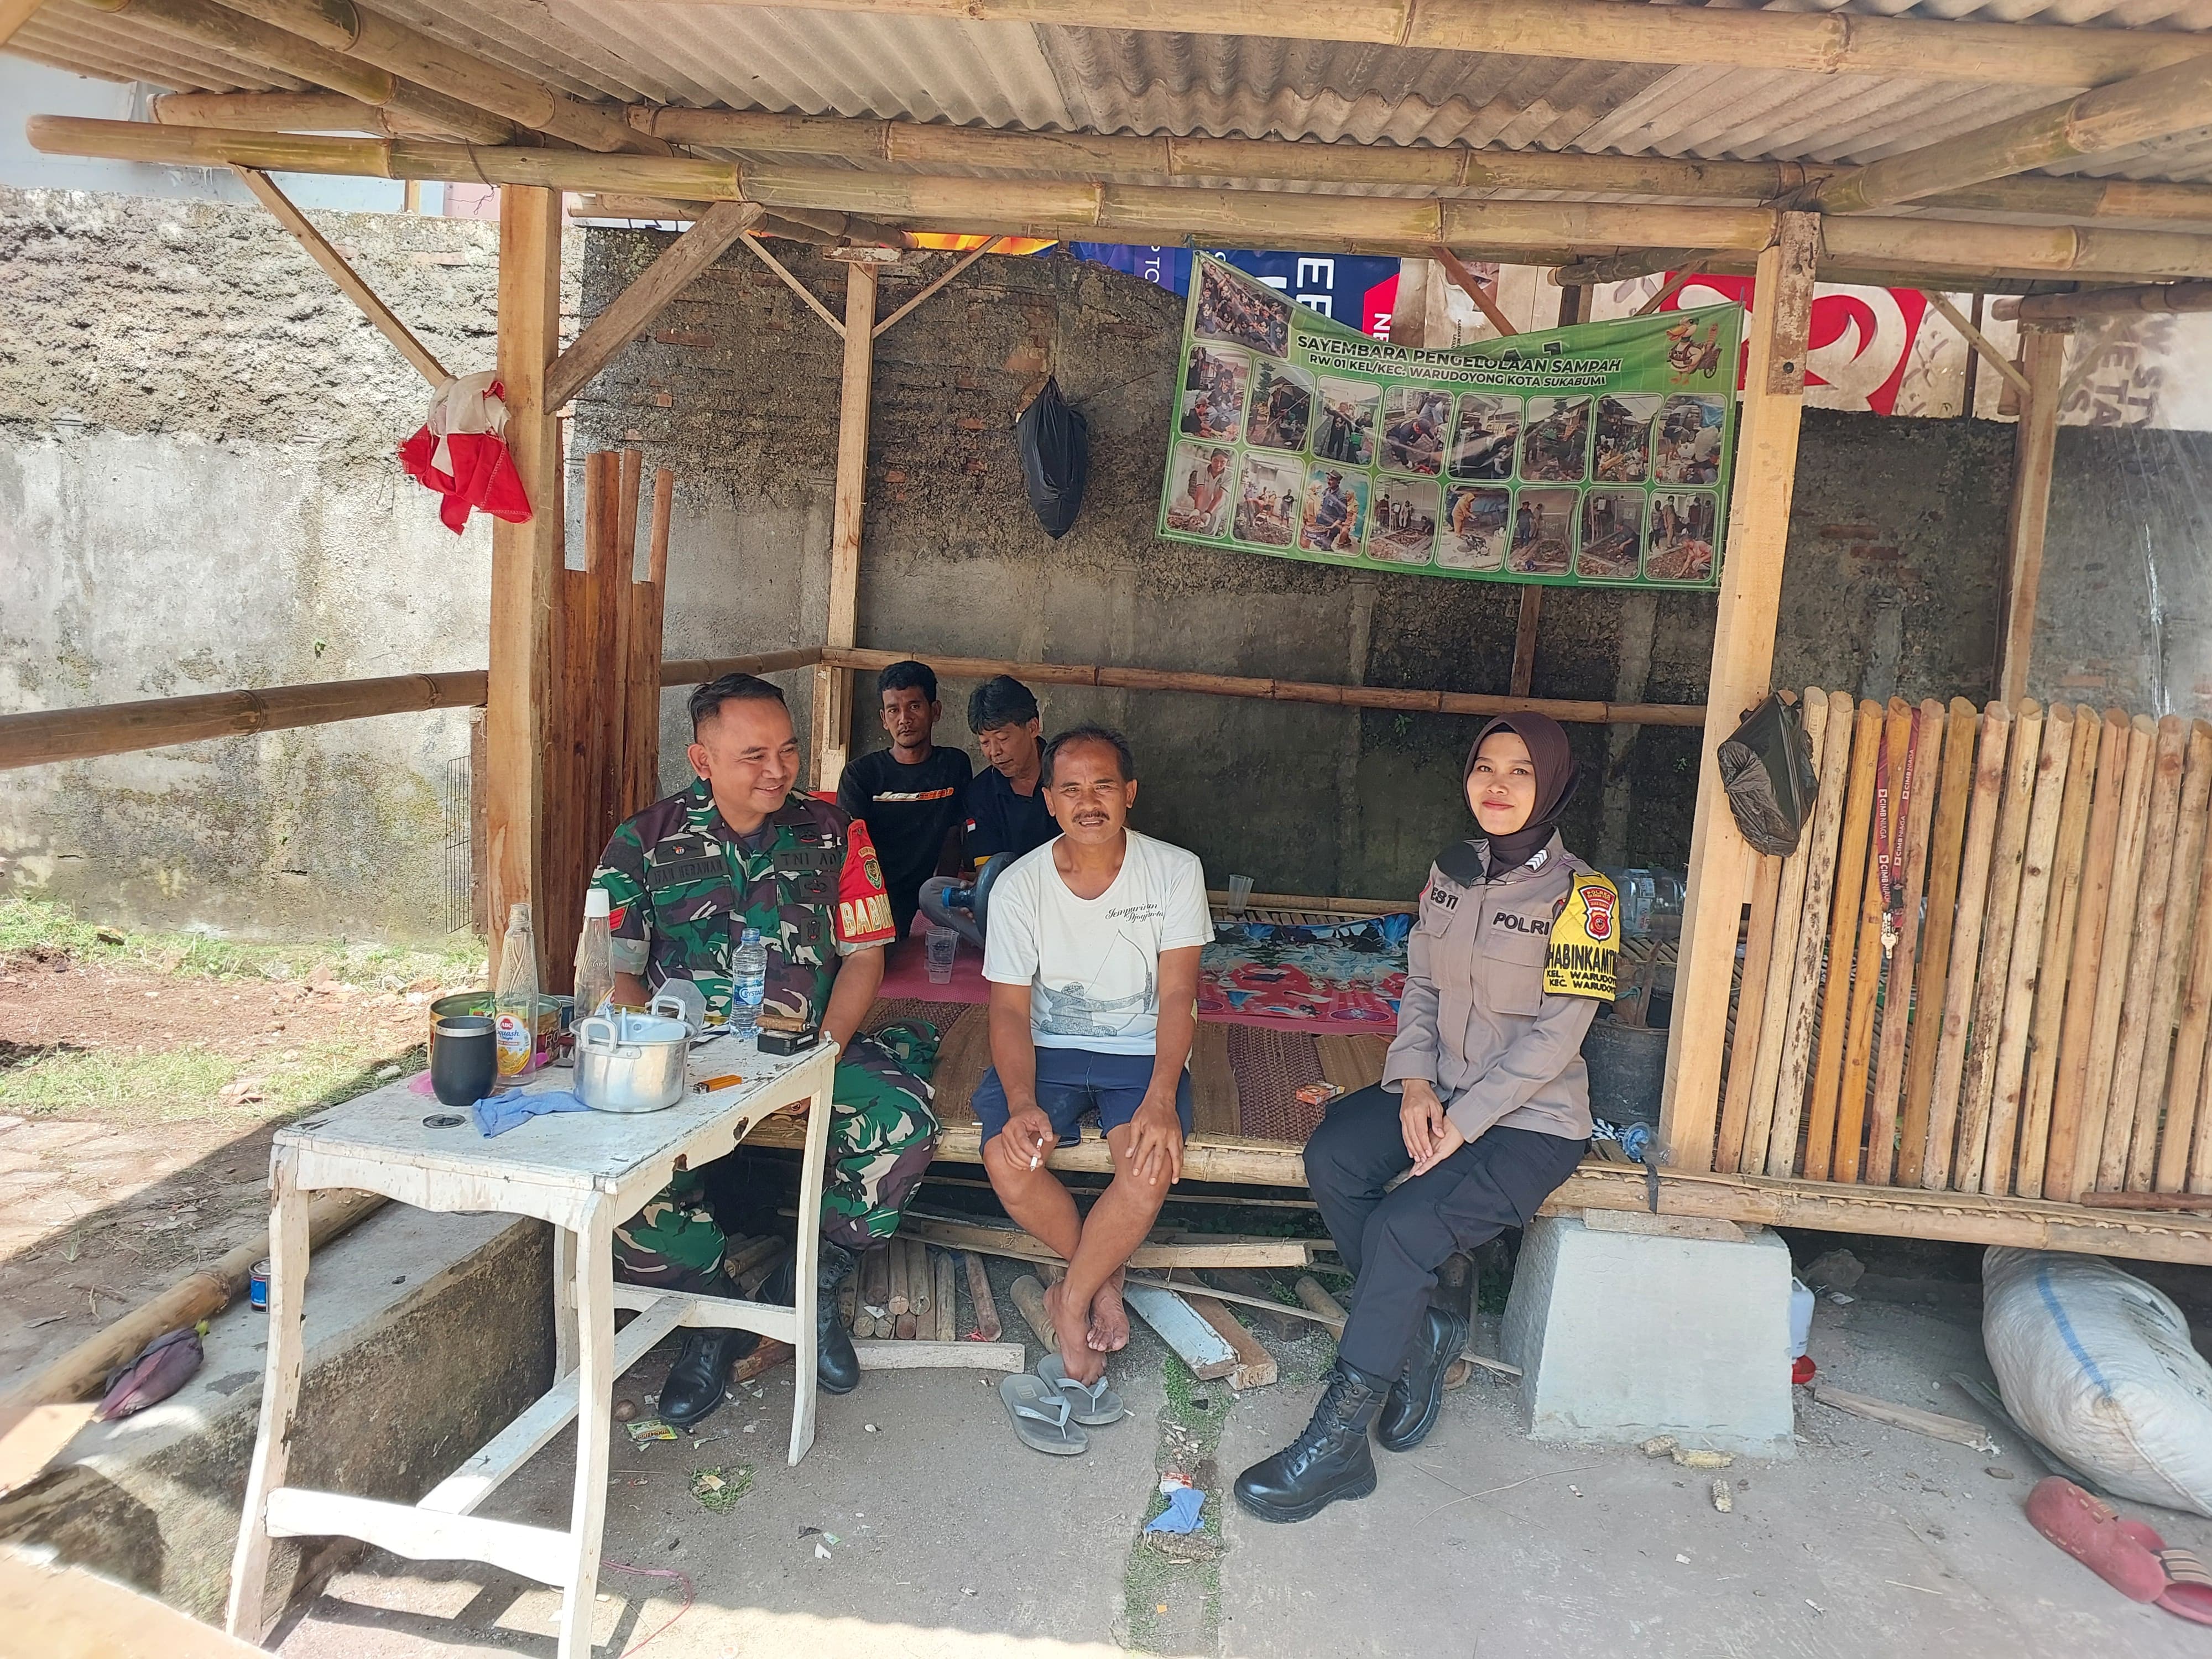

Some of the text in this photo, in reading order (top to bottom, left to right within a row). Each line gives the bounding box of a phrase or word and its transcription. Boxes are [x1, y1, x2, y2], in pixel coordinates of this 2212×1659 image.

[1297, 336, 1408, 361] SAYEMBARA
[1551, 359, 1621, 373] SAMPAH
[1309, 354, 1606, 387] RW 01 KEL/KEC. WARUDOYONG KOTA SUKABUMI
[780, 853, 837, 866] TNI AD
[1493, 912, 1550, 936] POLRI
